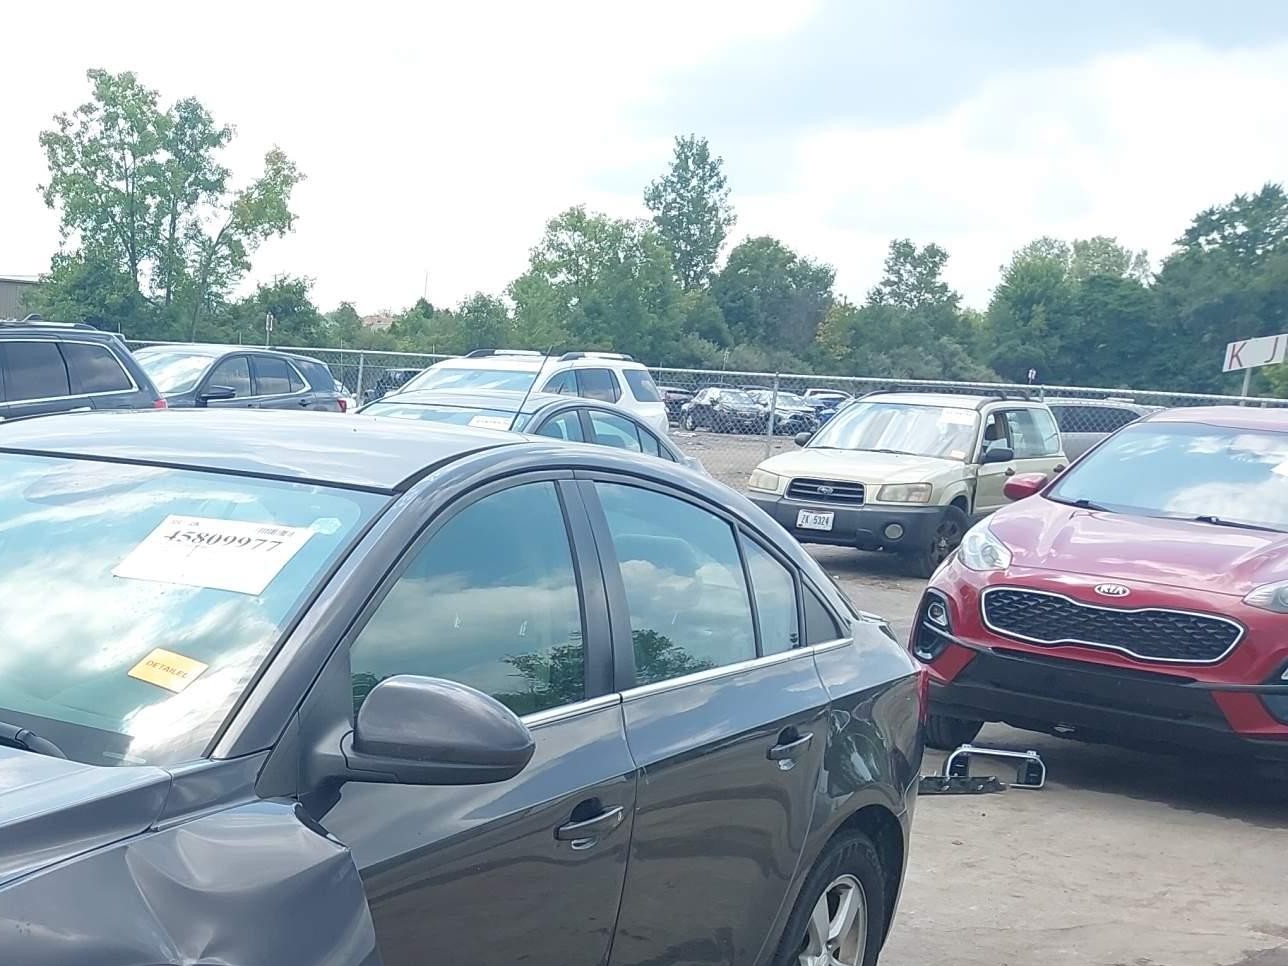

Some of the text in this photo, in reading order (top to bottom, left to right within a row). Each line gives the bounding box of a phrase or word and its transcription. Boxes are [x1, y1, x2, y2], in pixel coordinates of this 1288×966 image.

[1228, 337, 1279, 370] K J
[164, 529, 284, 551] 45809977
